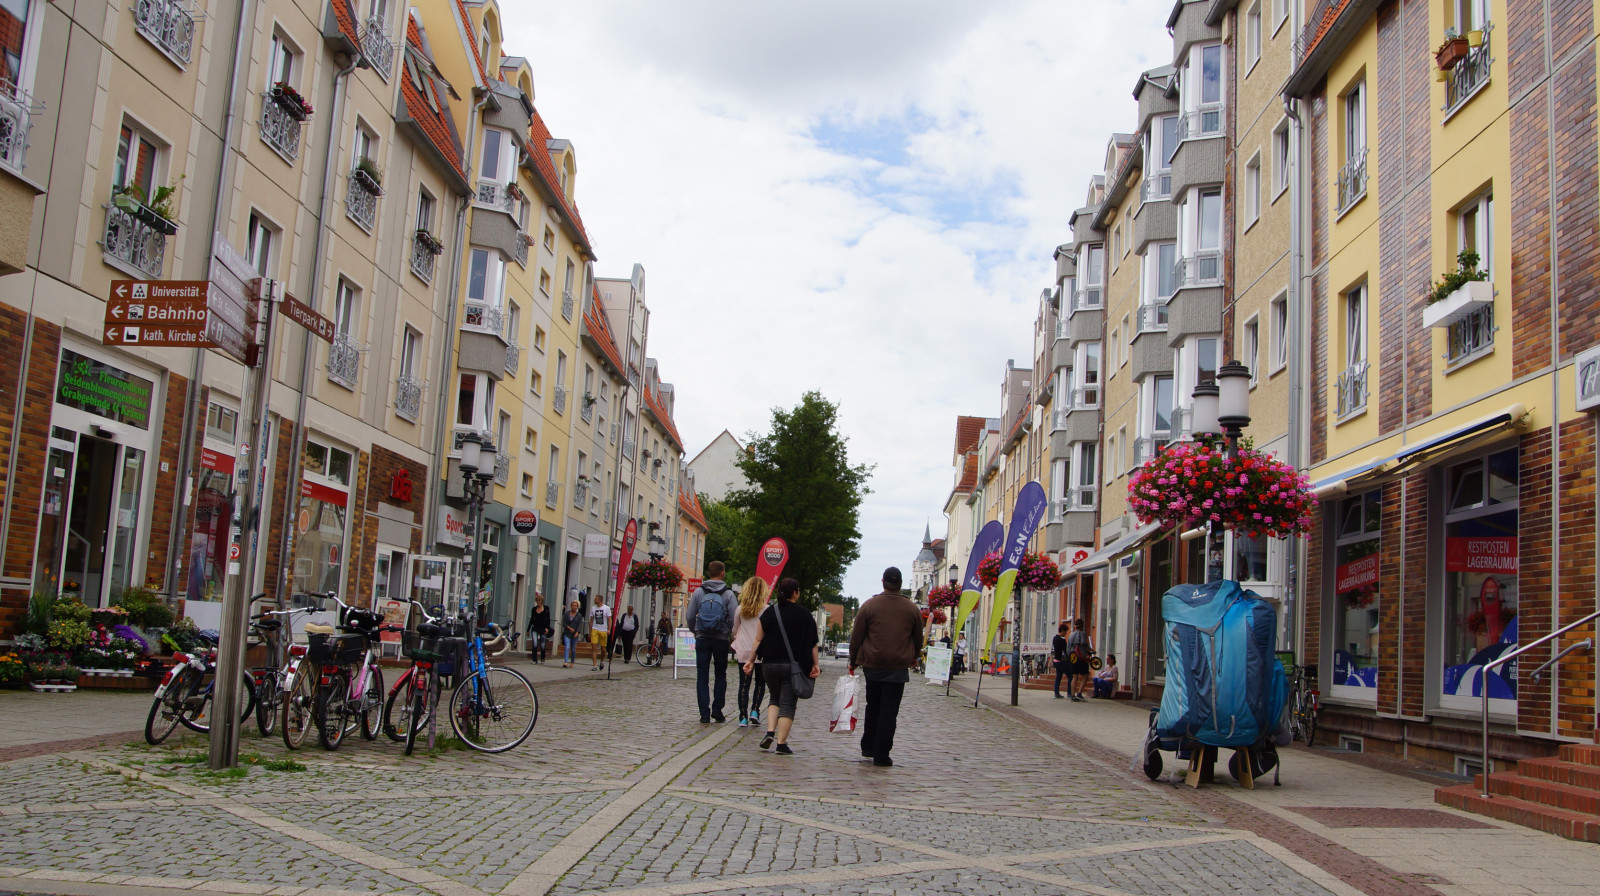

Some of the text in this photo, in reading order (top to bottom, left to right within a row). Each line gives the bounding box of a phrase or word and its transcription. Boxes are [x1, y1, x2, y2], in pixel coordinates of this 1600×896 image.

[152, 286, 199, 297] Universität
[148, 305, 207, 320] Bahnho
[290, 300, 317, 330] Tierpark
[144, 329, 166, 341] kath.
[168, 330, 197, 342] Kirche
[64, 372, 147, 409] Seidenblumengestecke
[99, 371, 148, 397] Fleuropdienst
[62, 385, 146, 421] Grabgebinde & Kränze
[391, 475, 413, 503] DER
[1008, 533, 1028, 565] E&N
[1467, 541, 1510, 554] RESTPOSTEN
[1348, 558, 1376, 576] RESTPOSTEN
[1338, 570, 1376, 590] LAGERRÄUMUNG
